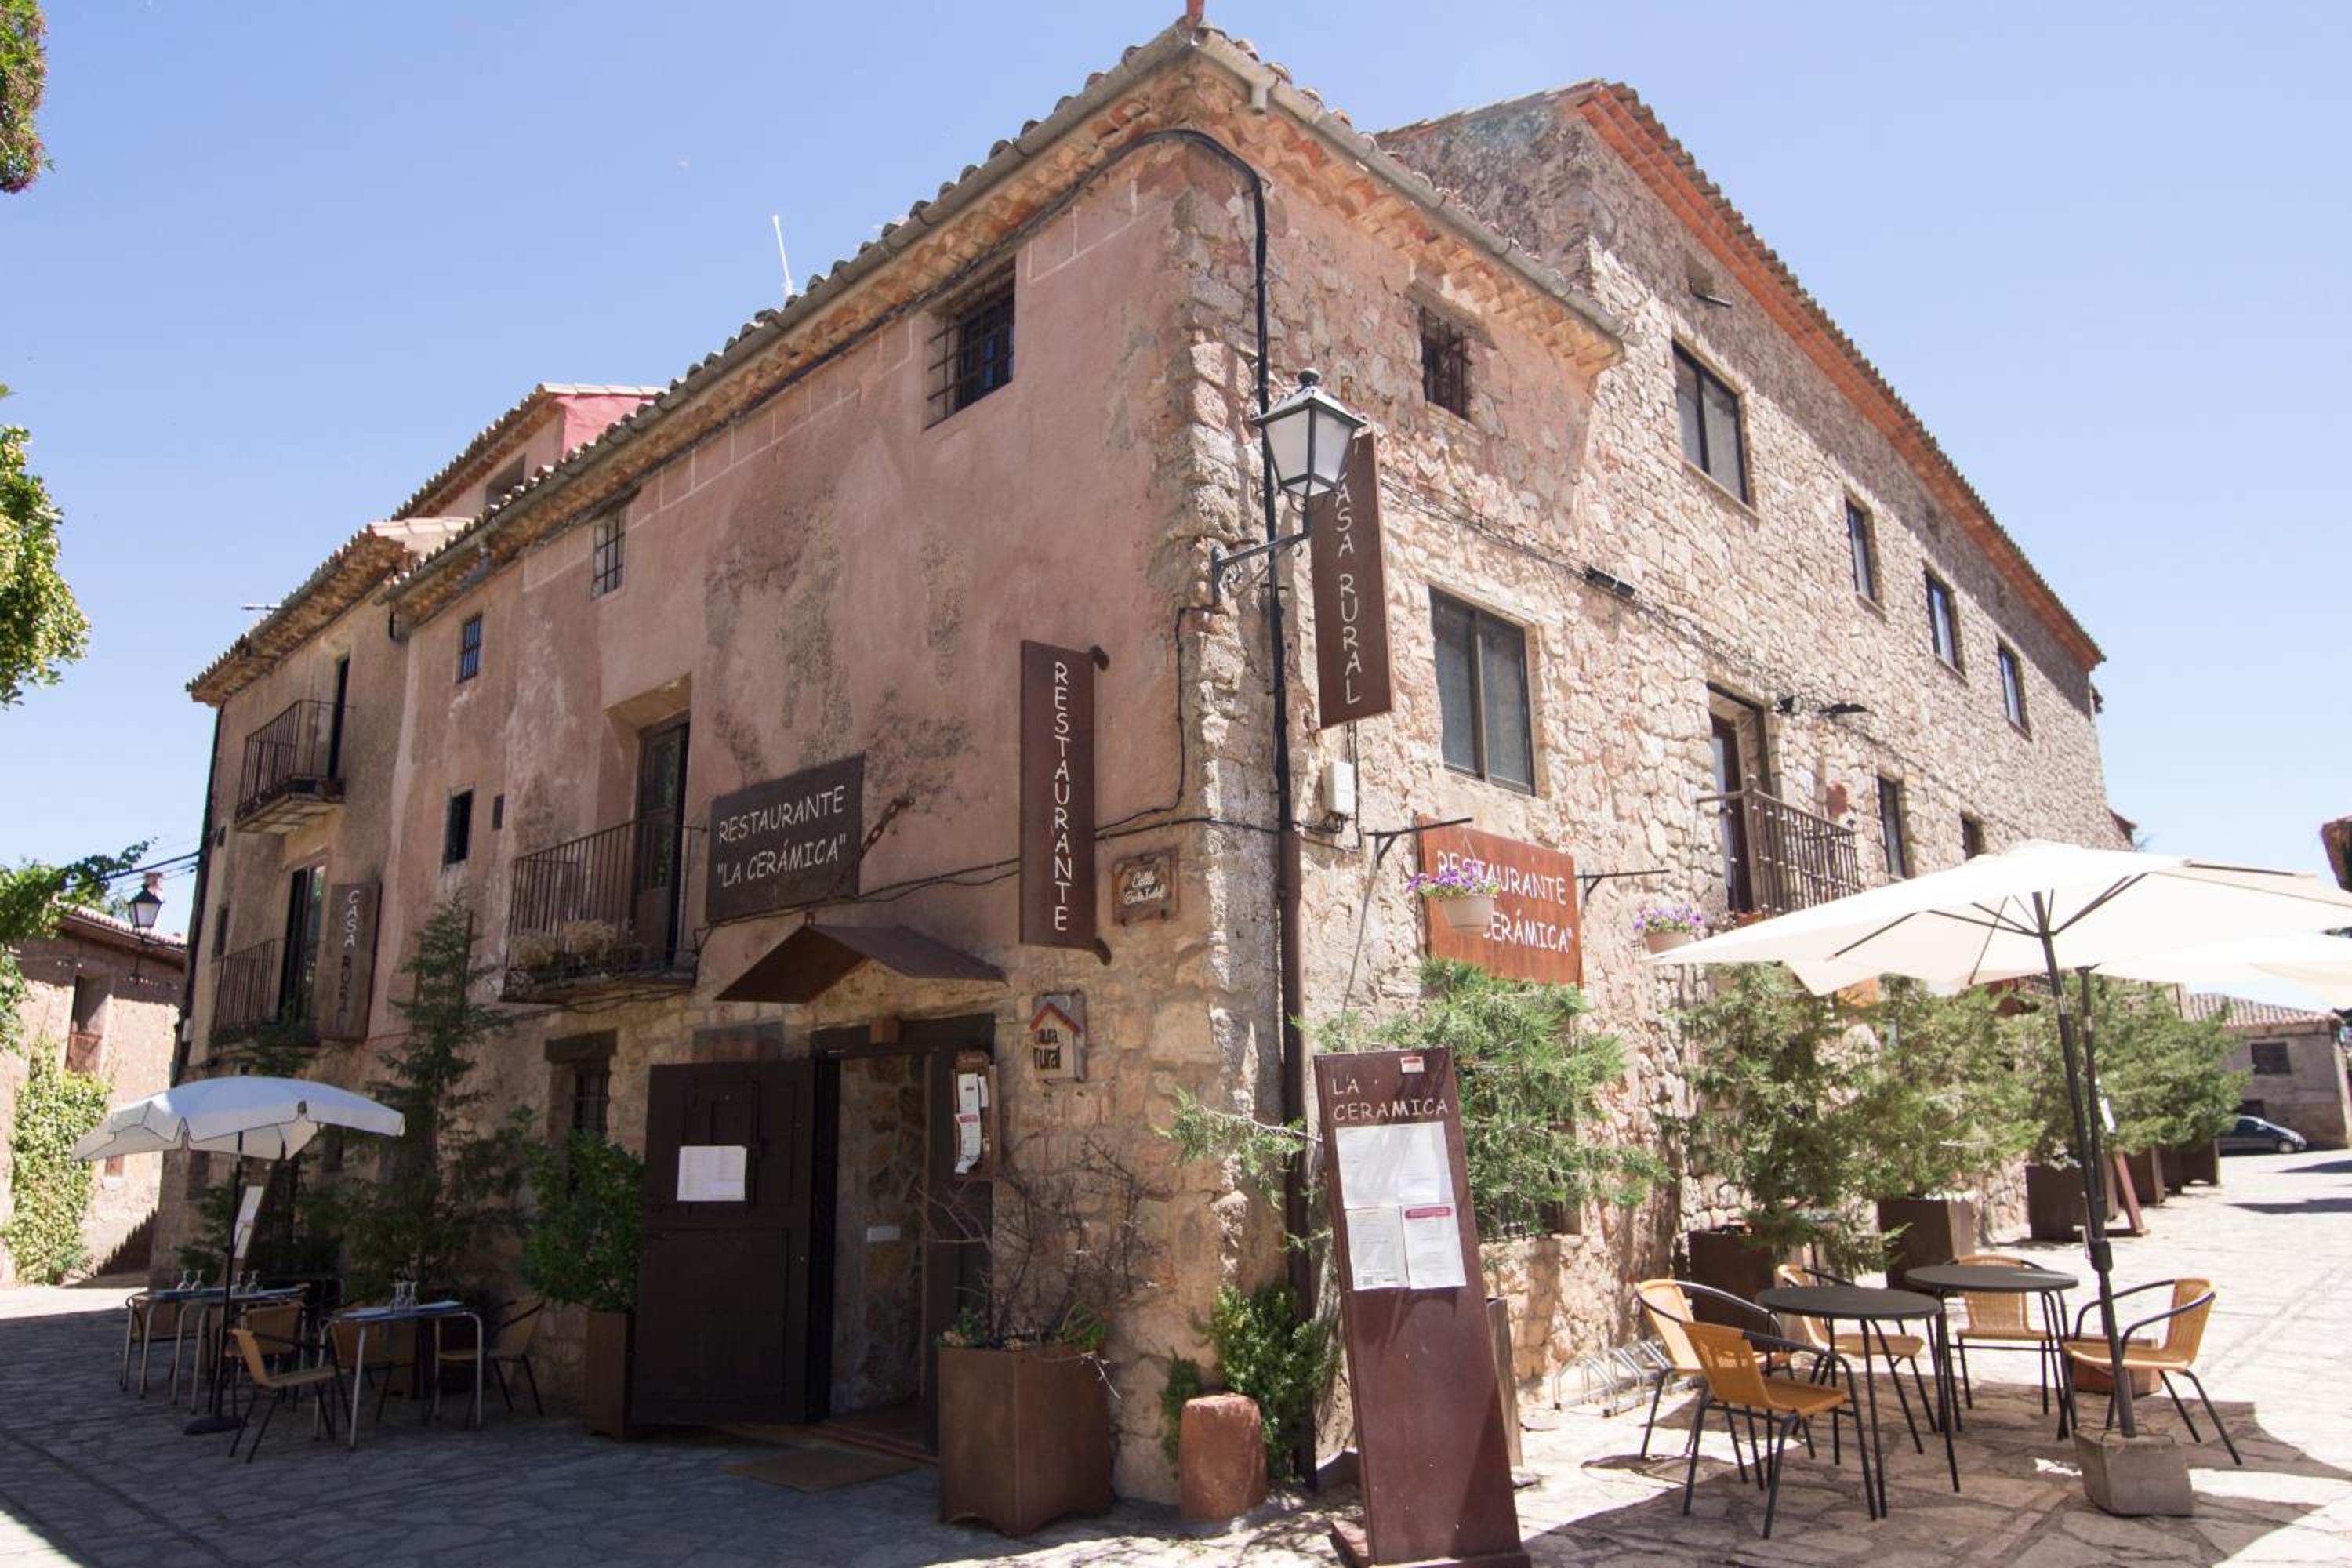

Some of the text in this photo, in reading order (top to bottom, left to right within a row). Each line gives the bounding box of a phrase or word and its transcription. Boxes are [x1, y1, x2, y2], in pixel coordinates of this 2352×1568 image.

[1335, 441, 1363, 705] ASA RURAL
[718, 785, 845, 845] RESTAURANTE
[1054, 662, 1073, 931] RESTAURANTE
[717, 832, 847, 887] "LA CERÁMICA"
[343, 889, 361, 949] CASA
[1482, 908, 1573, 954] ERÁMICA"
[1332, 1078, 1361, 1096] LA
[1333, 1097, 1450, 1122] CERAMICA
